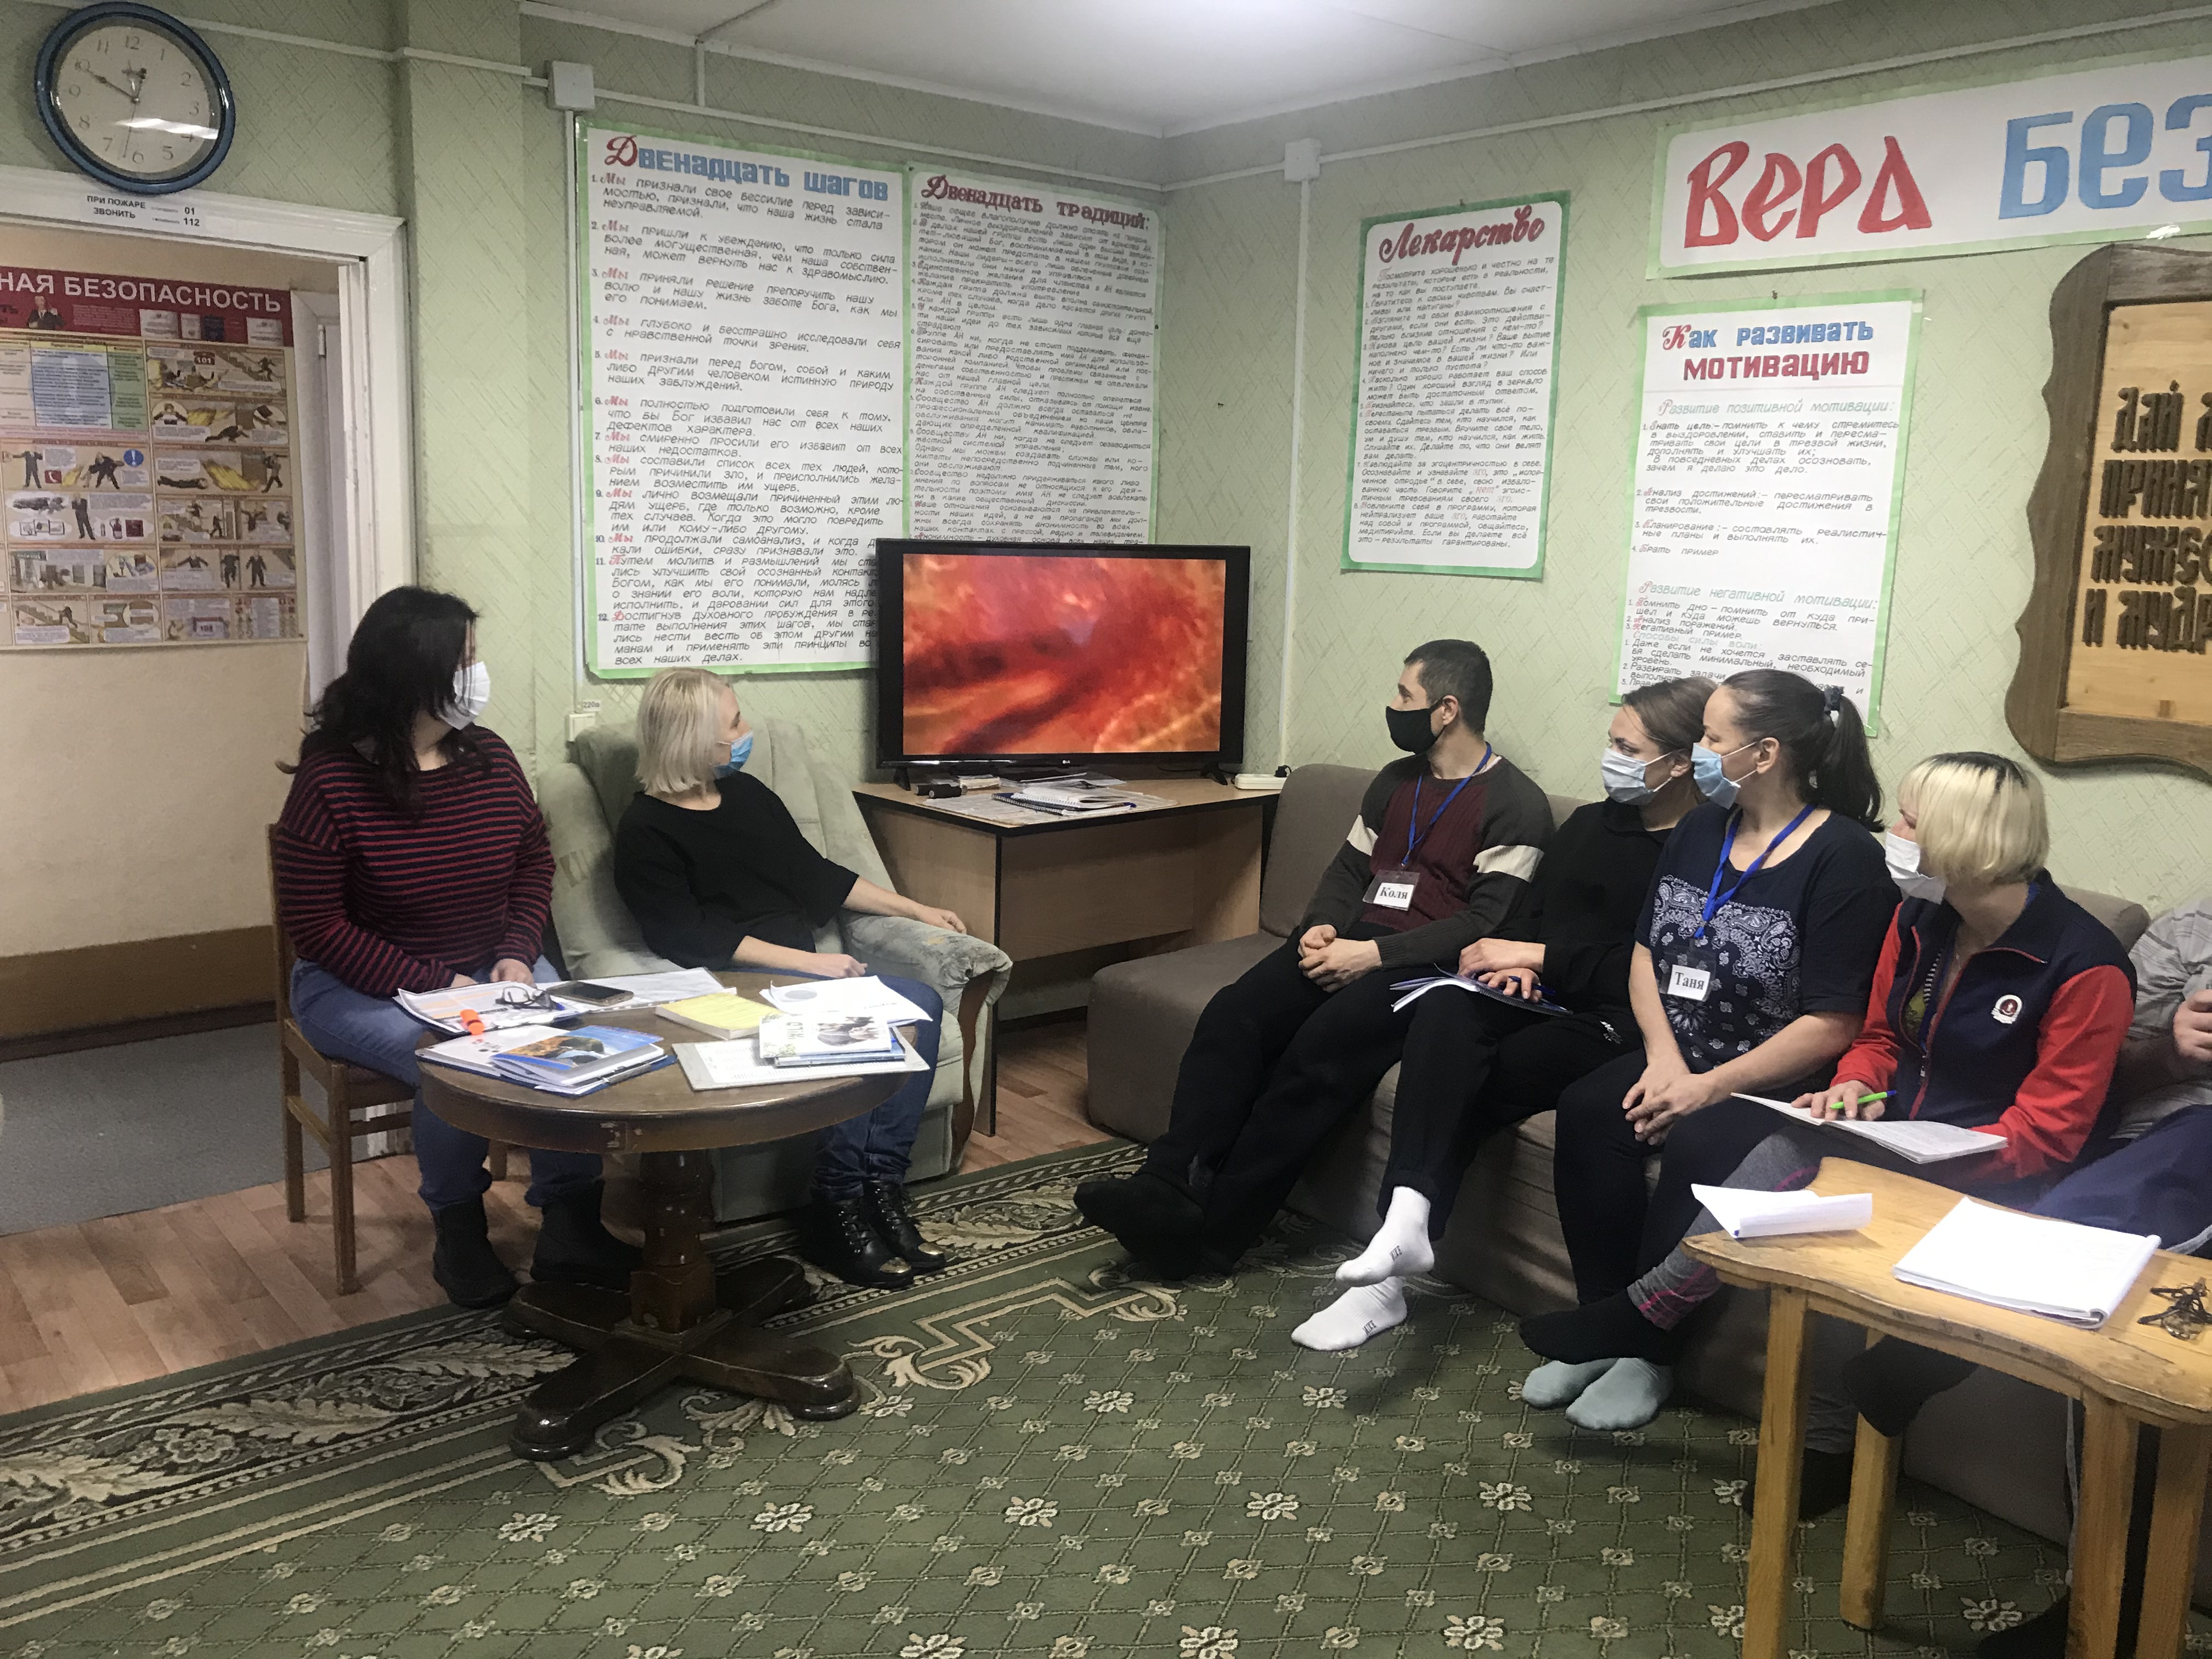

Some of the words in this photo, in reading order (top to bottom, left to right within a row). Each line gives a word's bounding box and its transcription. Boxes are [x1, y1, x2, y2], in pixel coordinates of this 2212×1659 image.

[97, 40, 109, 54] 11
[125, 36, 140, 50] 12
[160, 48, 165, 61] 1
[180, 71, 192, 87] 2
[189, 100, 199, 116] 3
[78, 114, 91, 130] 8
[103, 137, 113, 152] 7
[162, 145, 174, 160] 5
[87, 195, 105, 204] ПРИ
[108, 198, 146, 209] ПОЖАРЕ
[184, 207, 195, 215] 01
[93, 207, 136, 218] ЗВОНИТЬ
[183, 217, 200, 227] 112
[1379, 205, 1545, 266] Лекарство
[64, 276, 281, 313] БЕЗОПАСНОСТЬ
[1379, 887, 1409, 900] Коля
[1675, 971, 1706, 990] Таня
